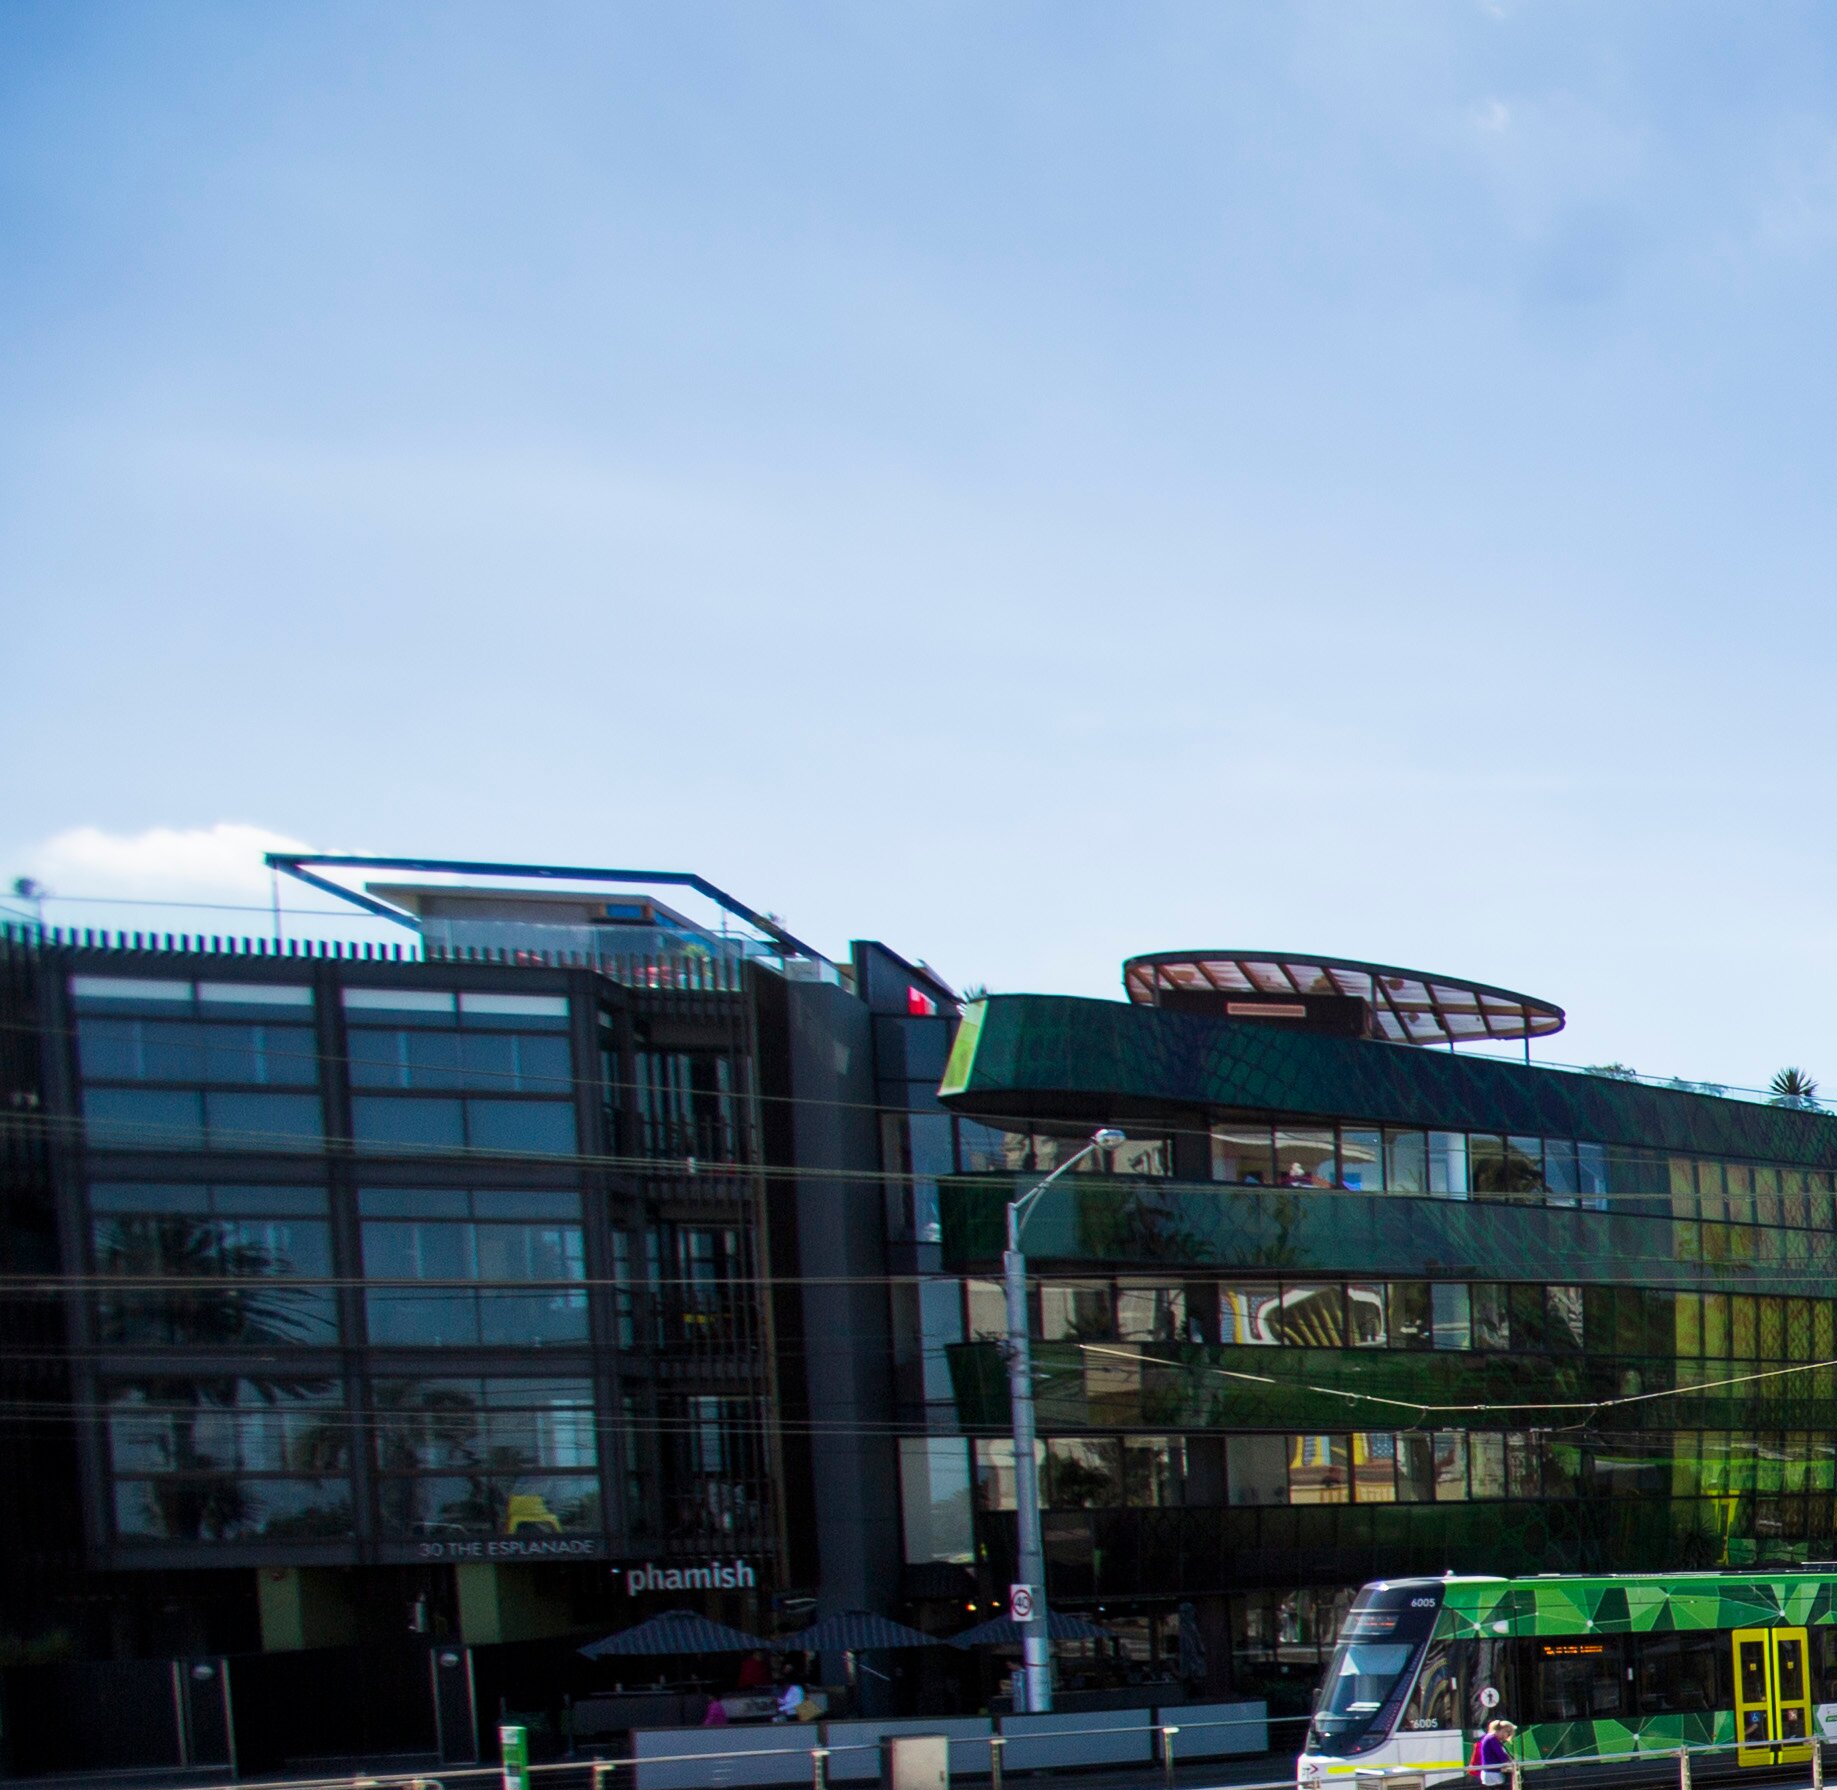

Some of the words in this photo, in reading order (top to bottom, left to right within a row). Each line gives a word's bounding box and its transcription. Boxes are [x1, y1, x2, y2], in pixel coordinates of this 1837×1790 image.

[419, 1543, 443, 1557] 30
[446, 1542, 483, 1556] THE
[488, 1539, 594, 1556] ESPLANADE
[626, 1560, 756, 1597] phamish
[1015, 1596, 1029, 1609] 40
[1411, 1598, 1436, 1608] 6005
[1413, 1718, 1438, 1729] 6005
